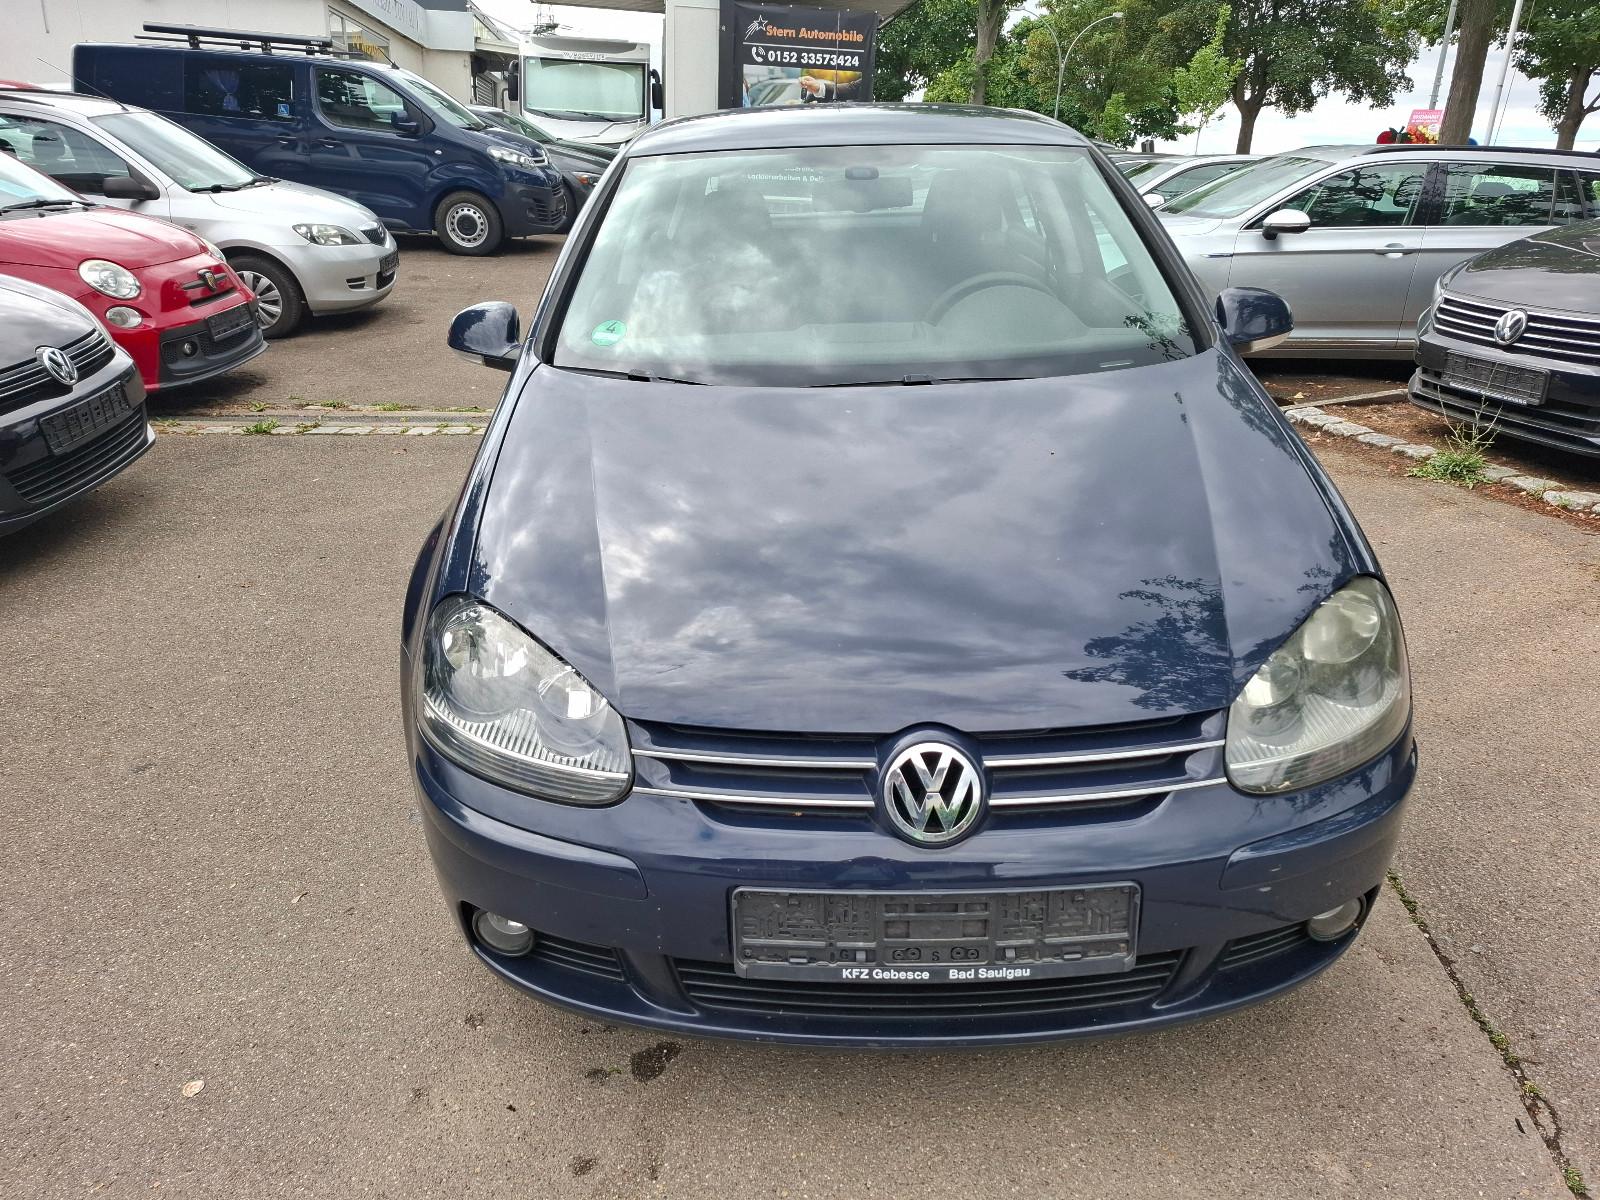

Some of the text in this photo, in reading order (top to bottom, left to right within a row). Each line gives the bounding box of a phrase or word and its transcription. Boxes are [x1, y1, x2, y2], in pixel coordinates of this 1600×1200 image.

[766, 25, 864, 42] Stern Automobile
[768, 50, 859, 67] 0152 33573424
[606, 321, 617, 333] 4
[842, 967, 1031, 980] KFZ Gebesce Bad Saulgau
